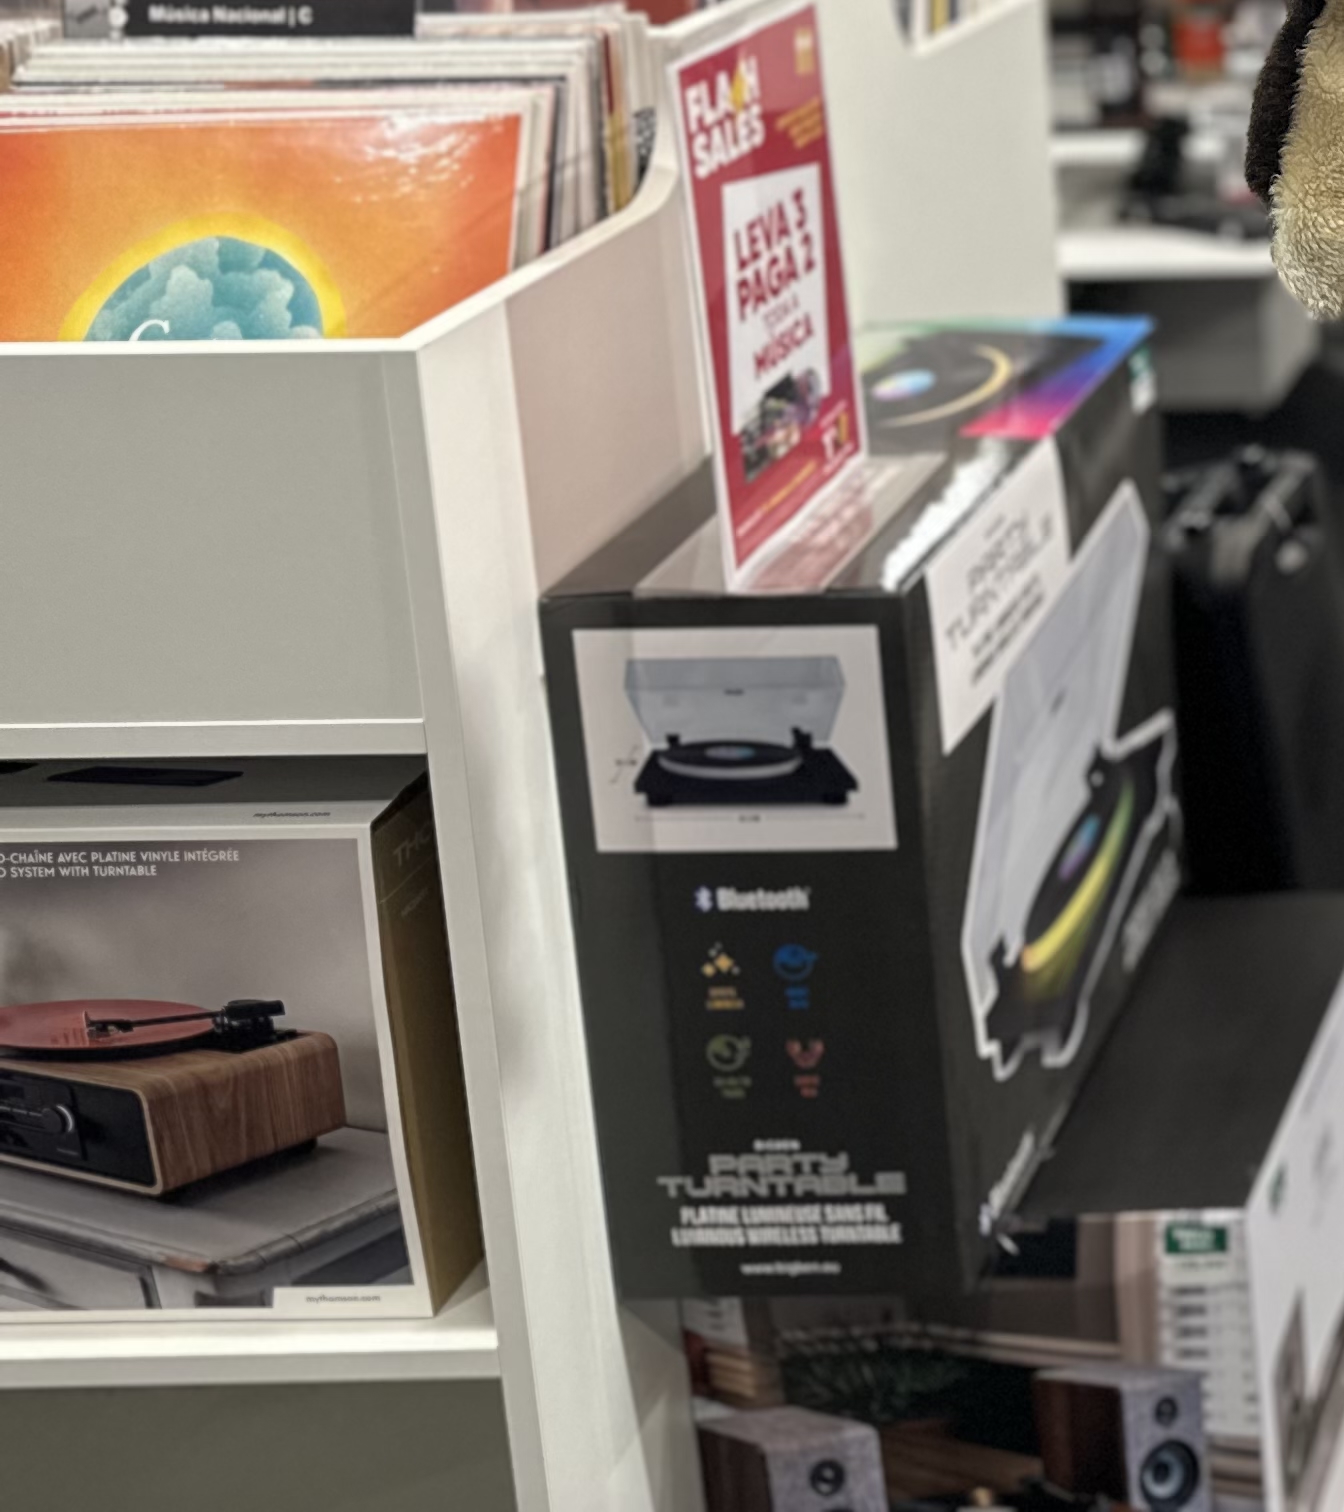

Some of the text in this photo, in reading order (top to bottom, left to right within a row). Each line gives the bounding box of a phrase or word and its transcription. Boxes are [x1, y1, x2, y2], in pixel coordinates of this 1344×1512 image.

[148, 3, 210, 23] Música
[212, 4, 286, 24] Nacional
[298, 4, 313, 25] C
[692, 104, 765, 179] SALES
[734, 187, 806, 271] LEVA 3
[738, 231, 815, 322] PAGA 2
[57, 851, 87, 863] AVEC
[91, 851, 137, 862] PLATINE
[140, 850, 180, 862] VINYLE
[184, 847, 239, 861] INTÉGRÉE
[10, 866, 55, 878] SYSTEM
[58, 866, 90, 877] WITH
[93, 865, 157, 876] TURNTABLE
[708, 1152, 849, 1175] PARTY
[656, 1172, 906, 1197] TURNTABLE
